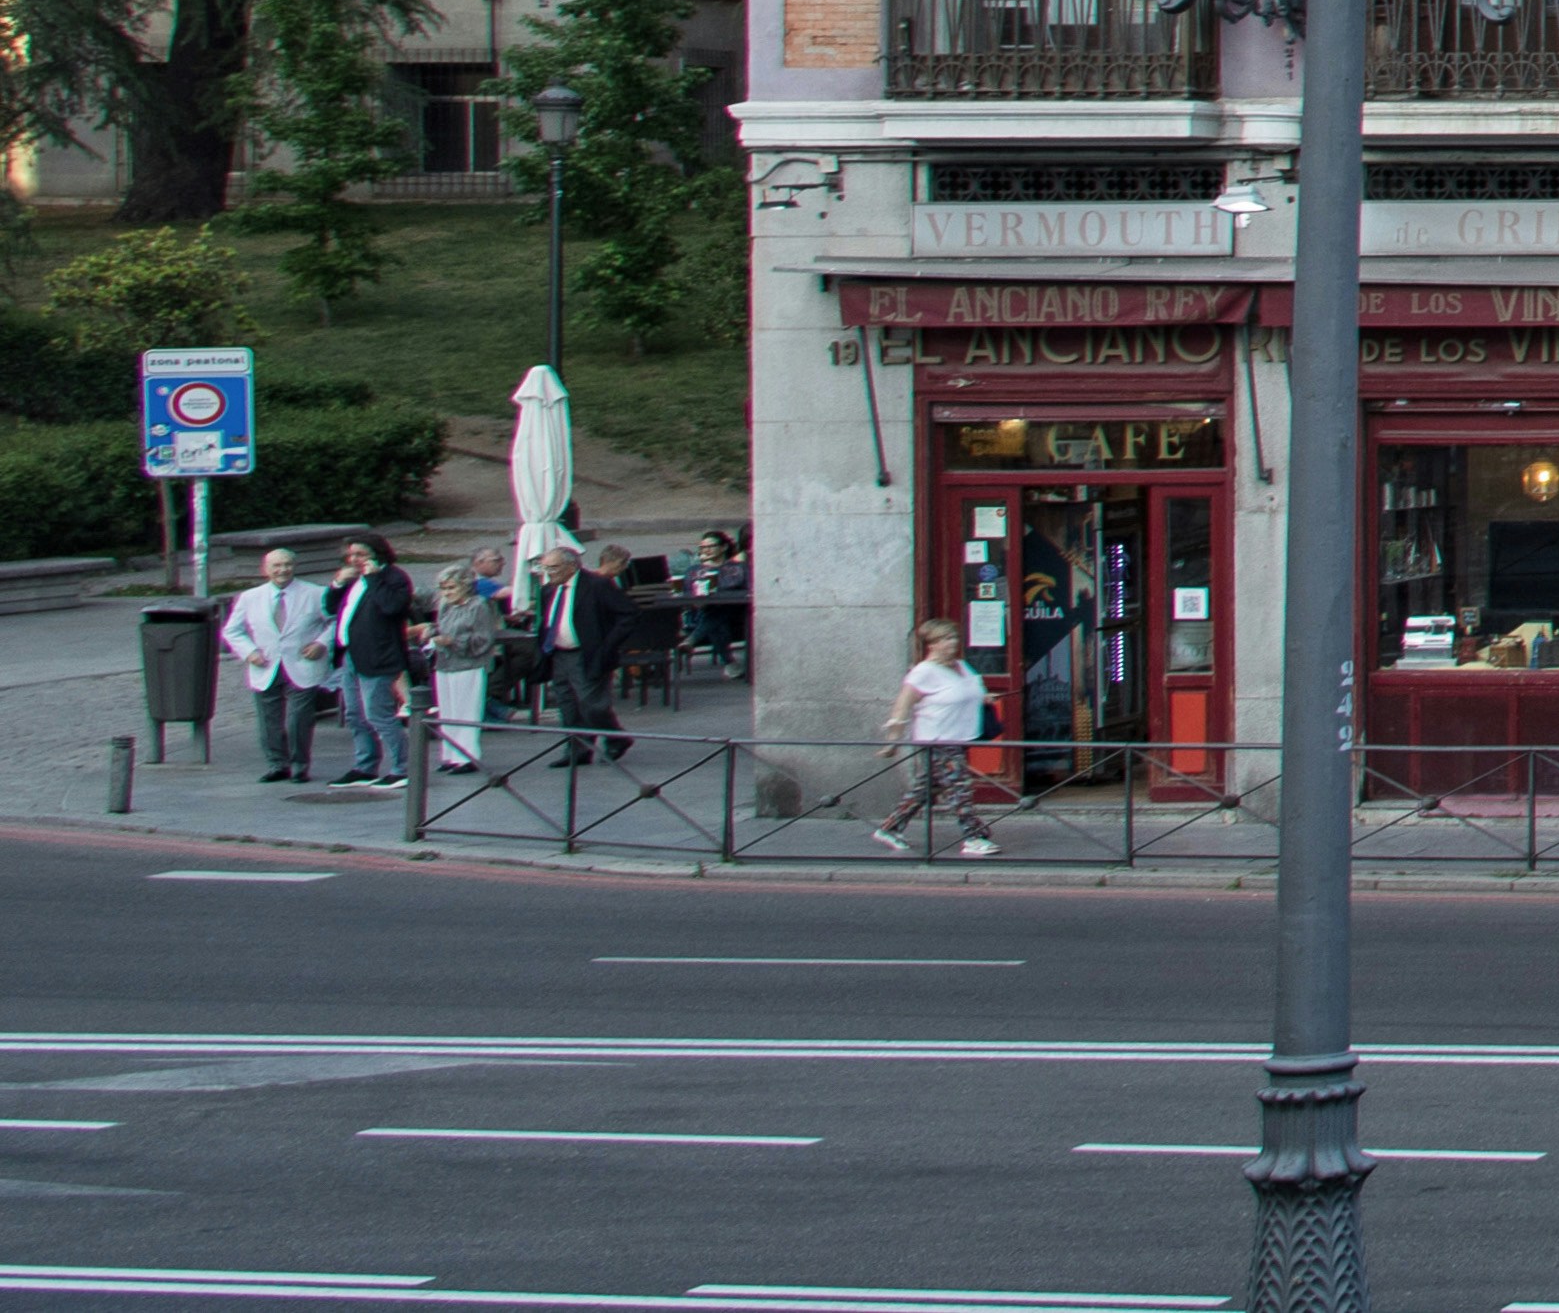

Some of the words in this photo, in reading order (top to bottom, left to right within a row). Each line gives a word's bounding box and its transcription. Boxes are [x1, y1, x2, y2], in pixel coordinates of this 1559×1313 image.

[925, 210, 1221, 248] VERMOUTH
[1395, 221, 1430, 246] de
[869, 286, 923, 323] EL
[946, 286, 1119, 323] ANCIANO
[1144, 285, 1229, 321] REY
[1410, 292, 1463, 314] LOS
[150, 358, 180, 366] zona
[187, 356, 245, 367] peatonal
[963, 327, 1222, 365] ANCIANO
[1361, 338, 1403, 363] DE
[1419, 338, 1488, 363] LOS
